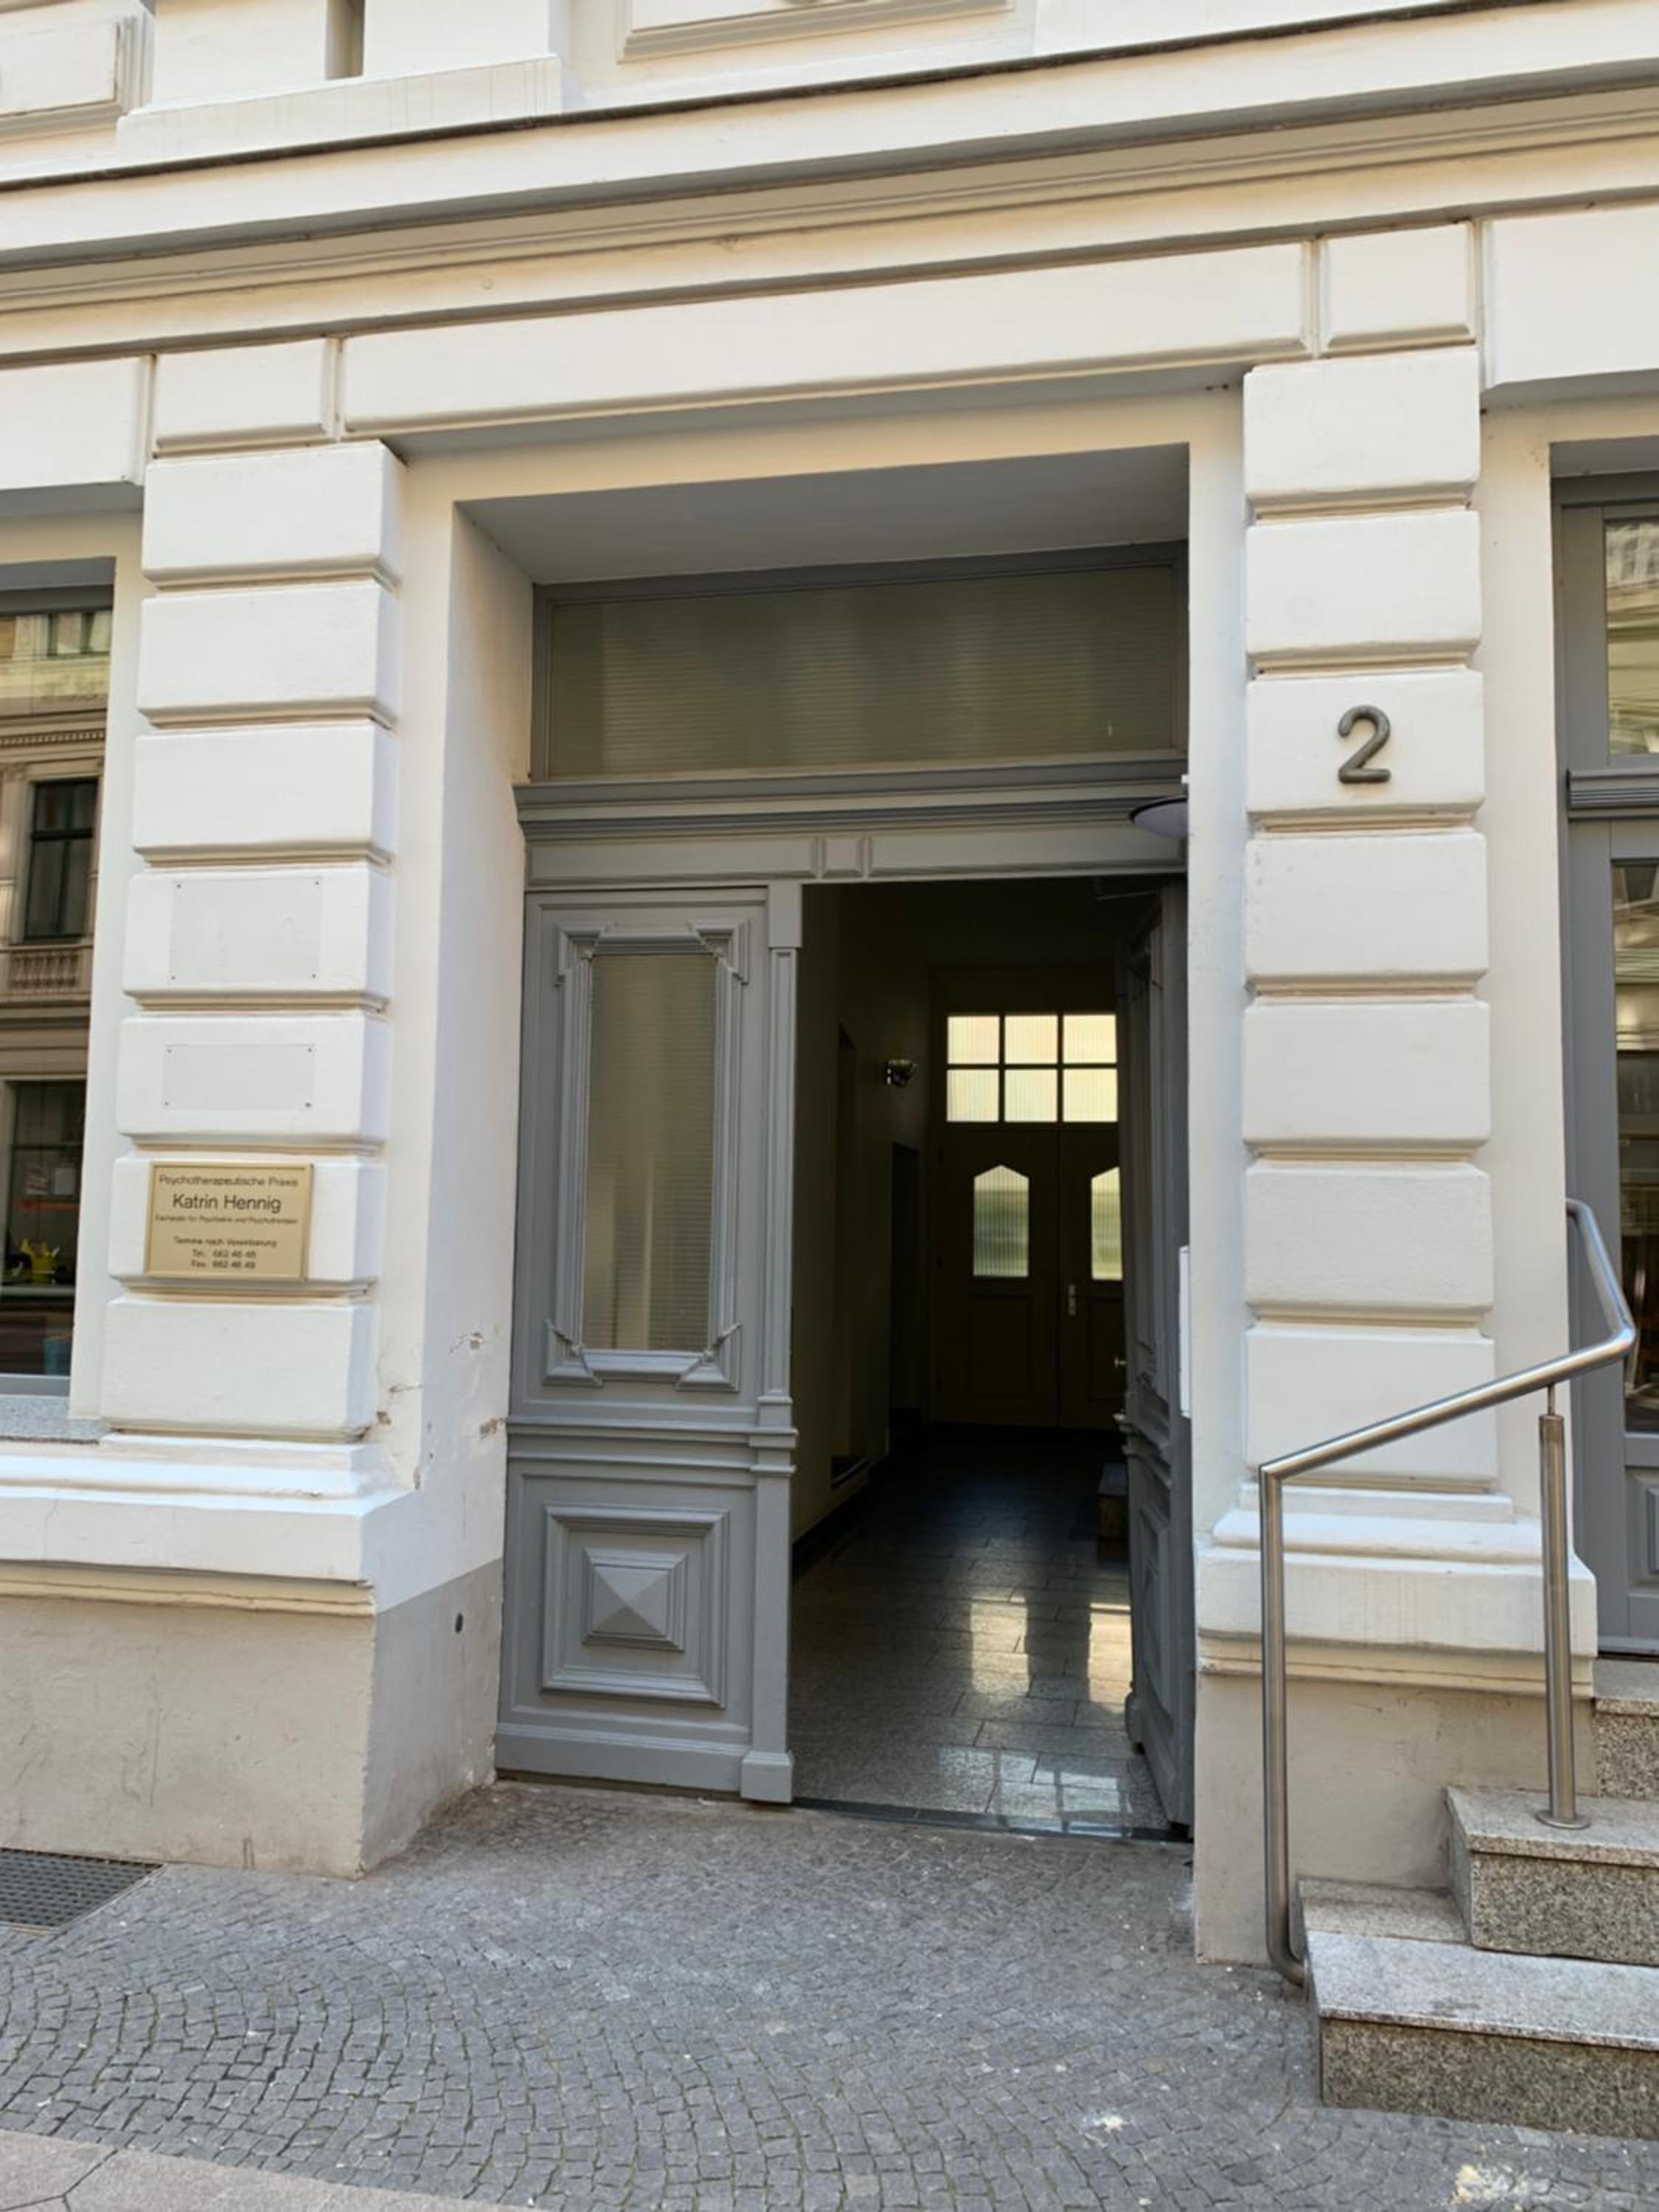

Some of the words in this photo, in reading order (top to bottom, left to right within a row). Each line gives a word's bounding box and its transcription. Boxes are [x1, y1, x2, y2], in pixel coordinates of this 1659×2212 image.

[1338, 705, 1391, 785] 2
[159, 1174, 265, 1187] Psychotherapeutische
[268, 1176, 299, 1188] Praxis
[172, 1193, 218, 1209] Katrin
[223, 1194, 282, 1214] Hennig
